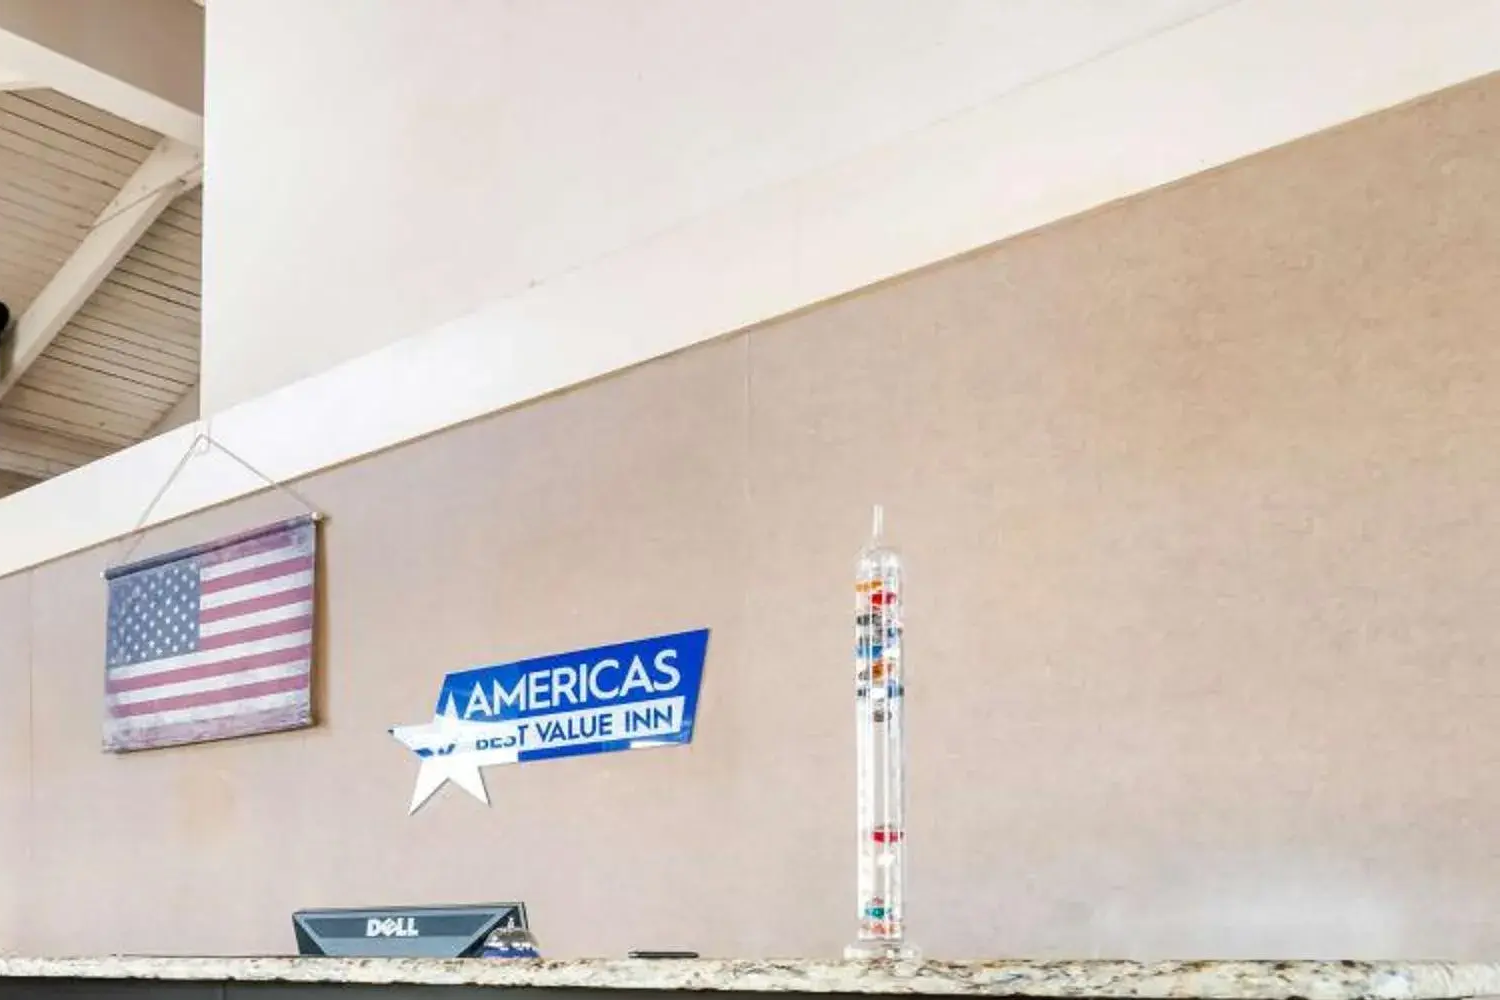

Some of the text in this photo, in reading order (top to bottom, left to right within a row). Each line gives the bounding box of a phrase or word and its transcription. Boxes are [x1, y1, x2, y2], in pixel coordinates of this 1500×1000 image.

[463, 648, 681, 719] AMERICAS
[535, 713, 613, 743] VALUE
[624, 704, 674, 733] INN
[366, 917, 419, 937] DELL
